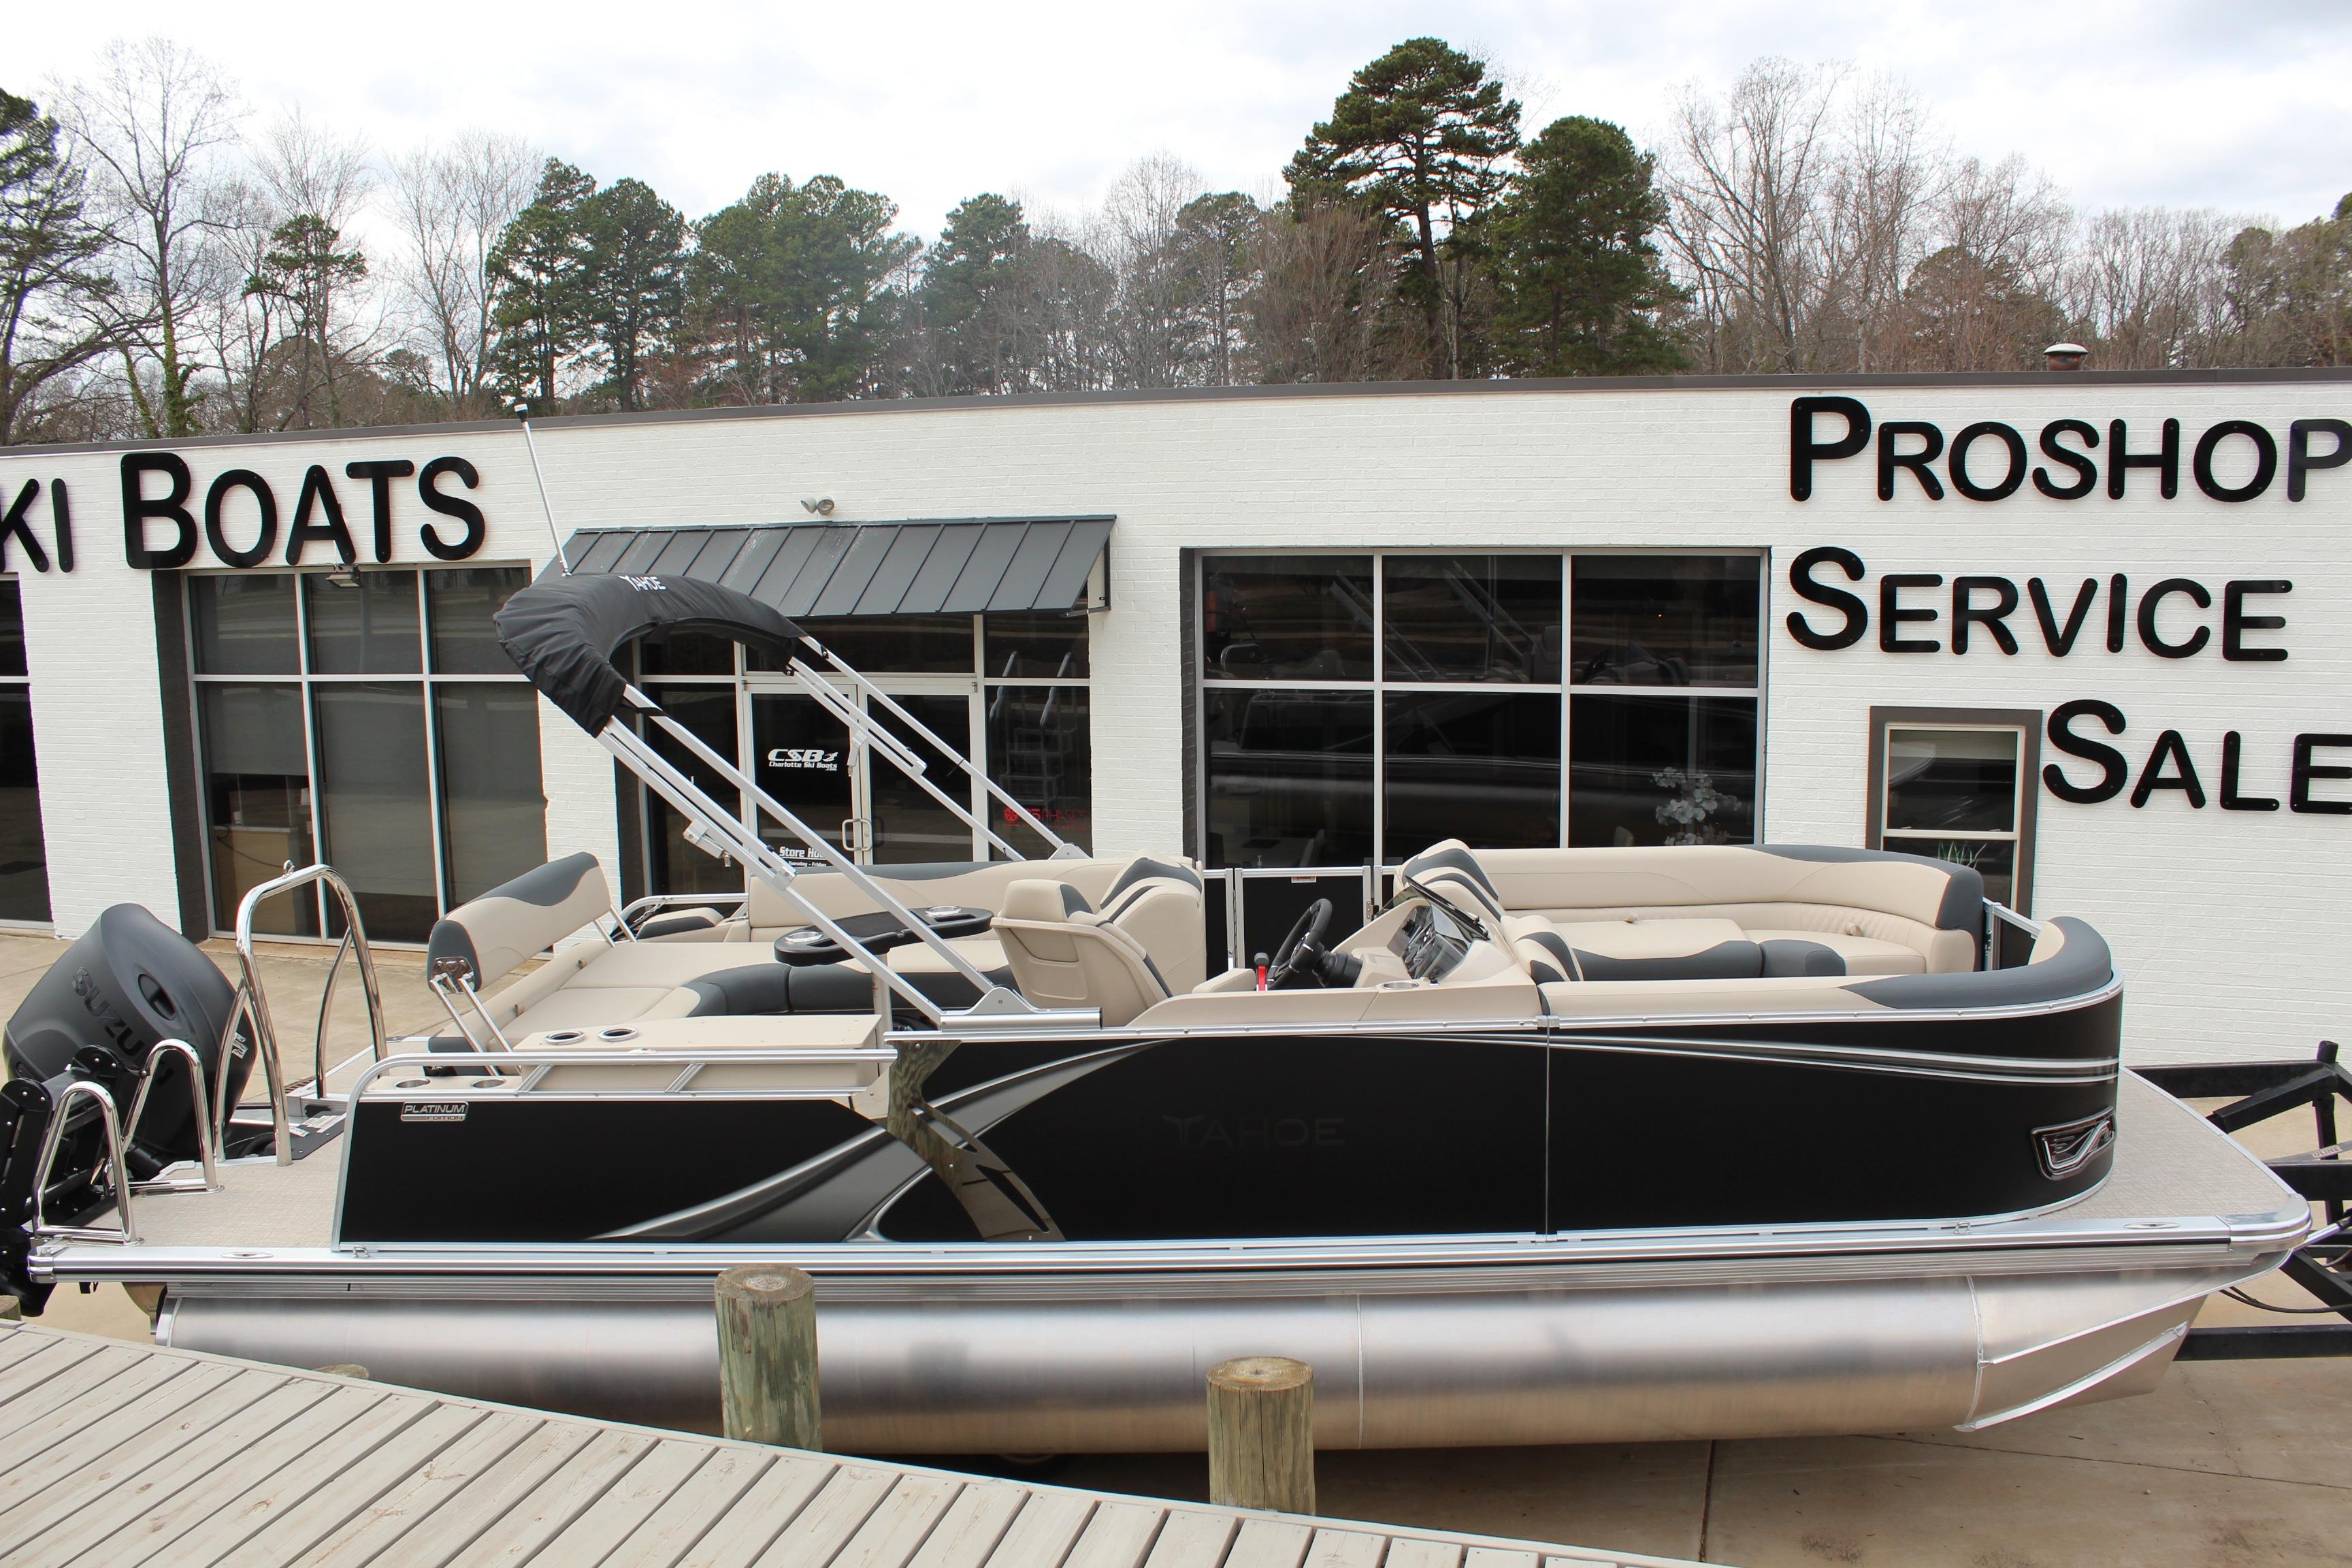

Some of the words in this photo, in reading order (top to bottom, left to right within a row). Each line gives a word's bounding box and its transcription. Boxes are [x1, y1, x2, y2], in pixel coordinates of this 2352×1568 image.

[1791, 397, 2352, 502] PROSHOP
[120, 452, 485, 569] BOATS
[1786, 546, 2293, 662] SERVICE
[768, 749, 825, 762] CSB
[2042, 699, 2352, 815] SALE
[779, 846, 805, 858] Store
[71, 967, 175, 1085] SUZUI
[404, 1105, 466, 1113] PLATINUM
[1161, 1114, 1345, 1150] TAHOE
[2314, 1146, 2340, 1157] ULINE
